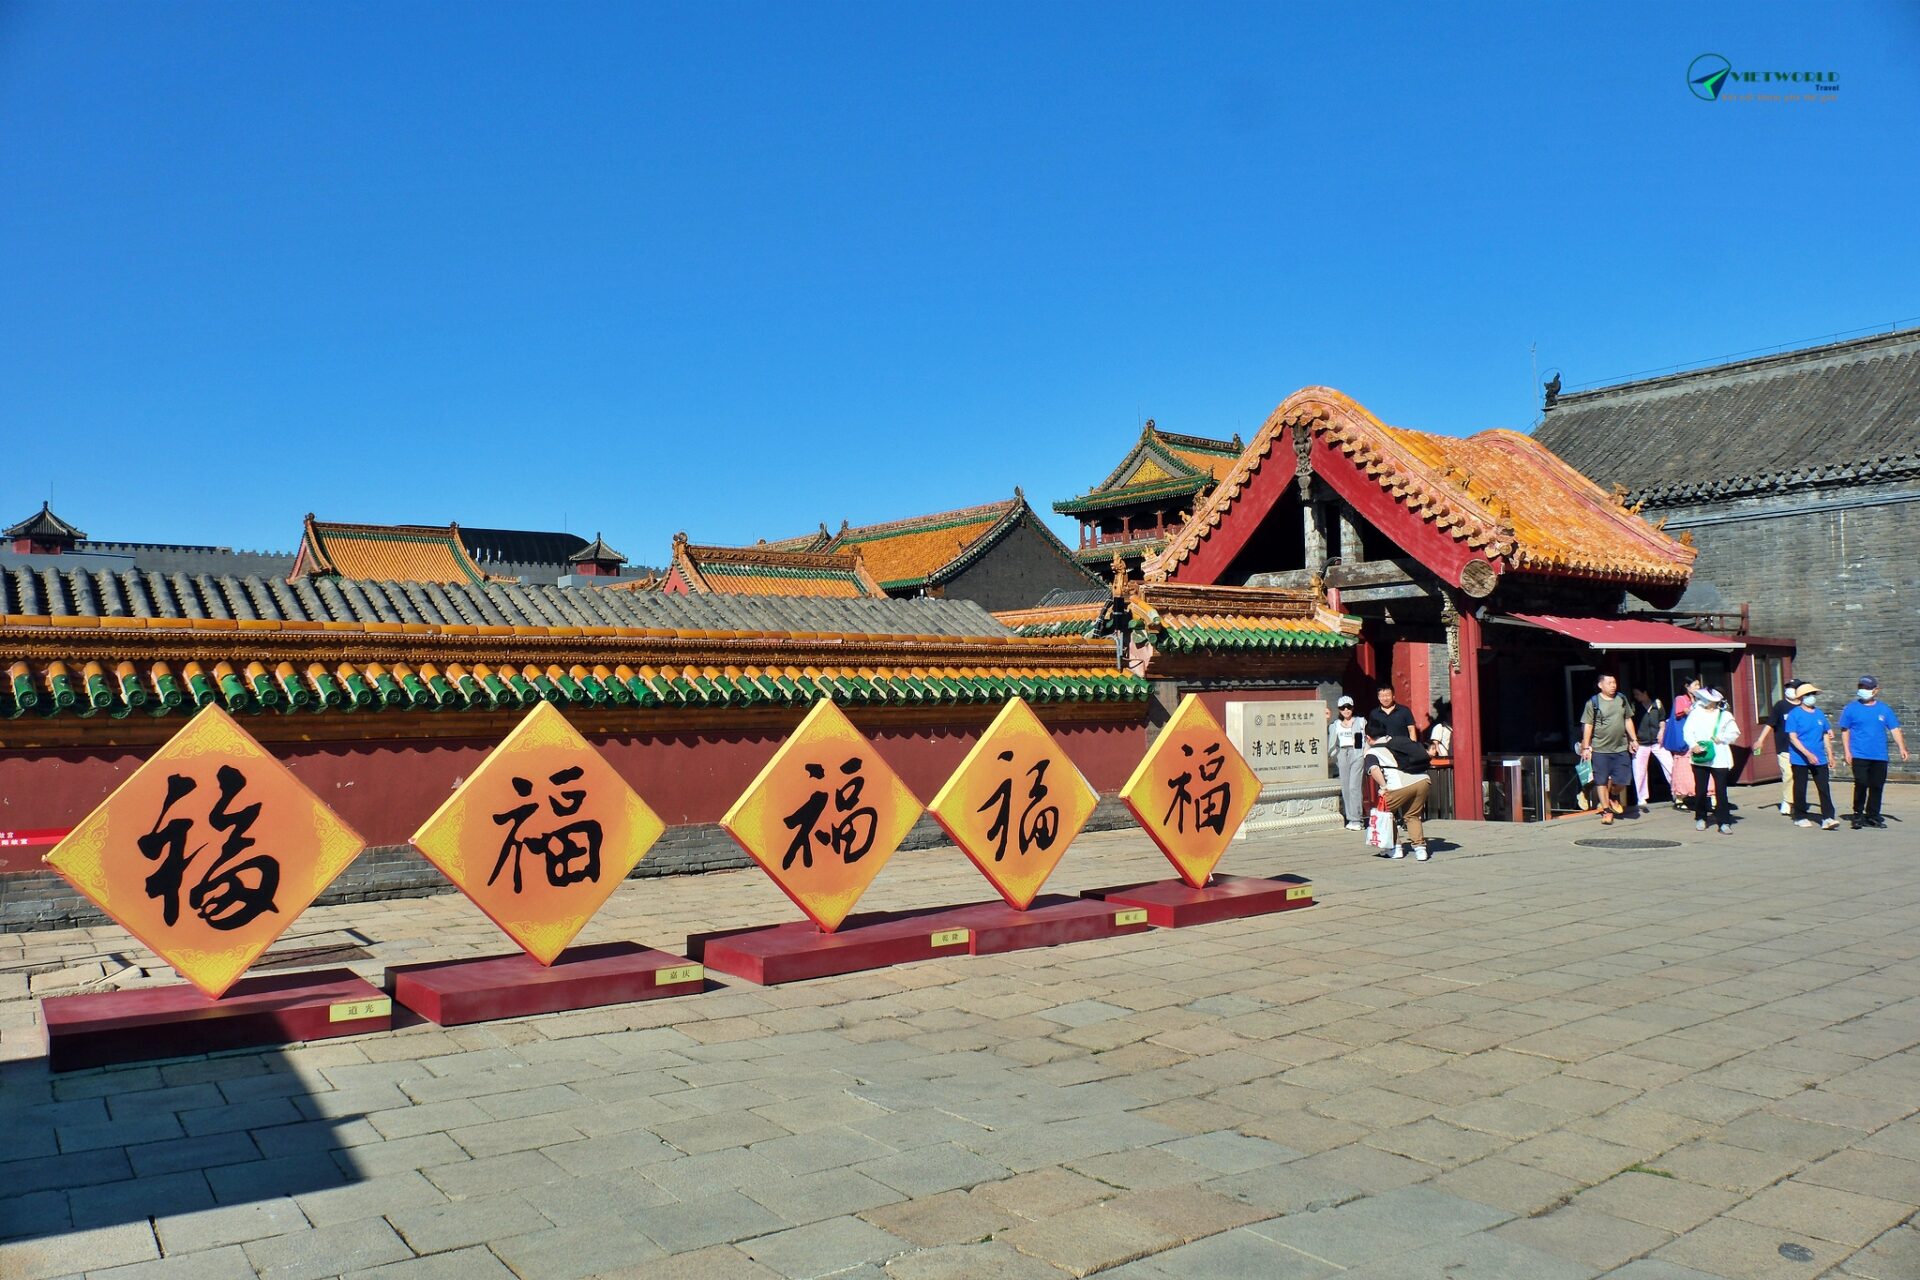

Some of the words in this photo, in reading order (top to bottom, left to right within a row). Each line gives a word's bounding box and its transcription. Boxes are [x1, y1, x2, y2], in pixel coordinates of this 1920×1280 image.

[1164, 743, 1230, 836] 福
[1252, 737, 1320, 757] 清沈阳故宫
[137, 765, 280, 931] 福
[487, 766, 603, 894] 福
[782, 757, 878, 870] 福
[977, 751, 1059, 862] 福
[348, 1003, 374, 1015] 道光
